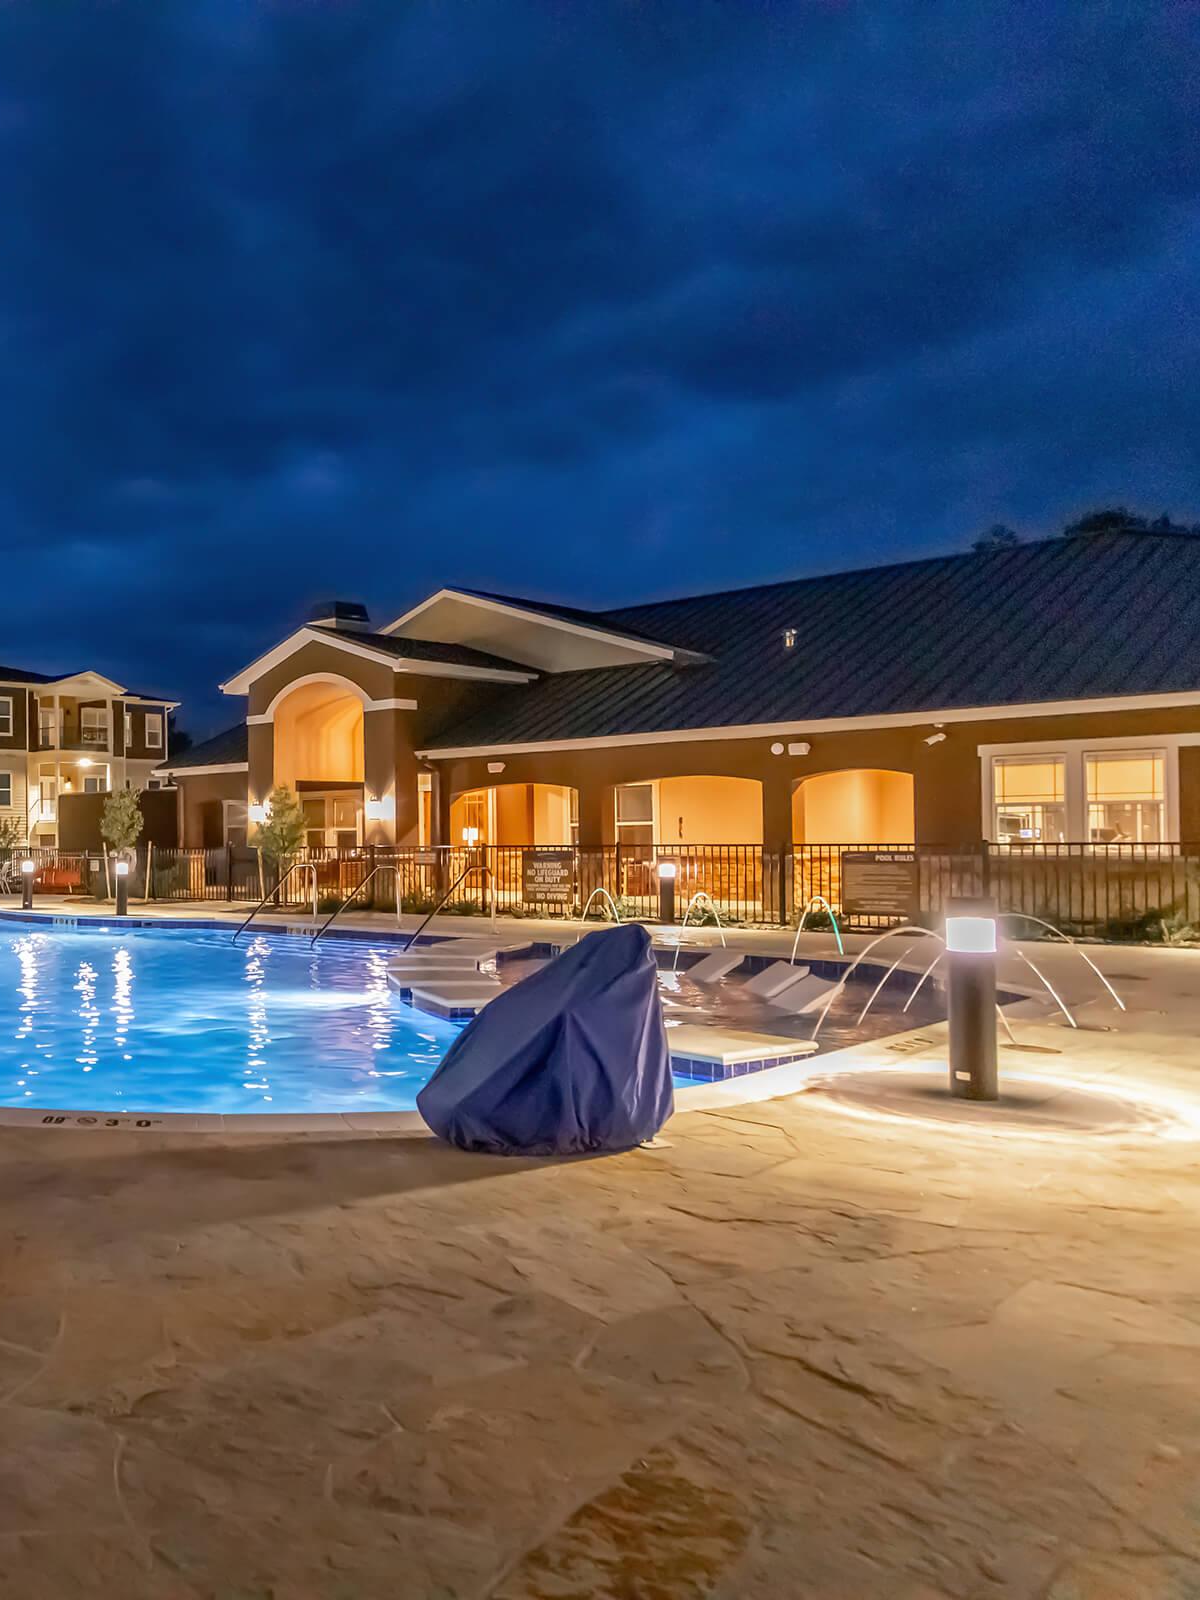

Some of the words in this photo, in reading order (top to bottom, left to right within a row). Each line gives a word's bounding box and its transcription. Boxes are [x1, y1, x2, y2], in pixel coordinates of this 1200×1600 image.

[875, 854, 892, 862] POOL
[894, 854, 914, 862] RULES
[536, 892, 546, 900] NO
[546, 892, 568, 900] DIVING
